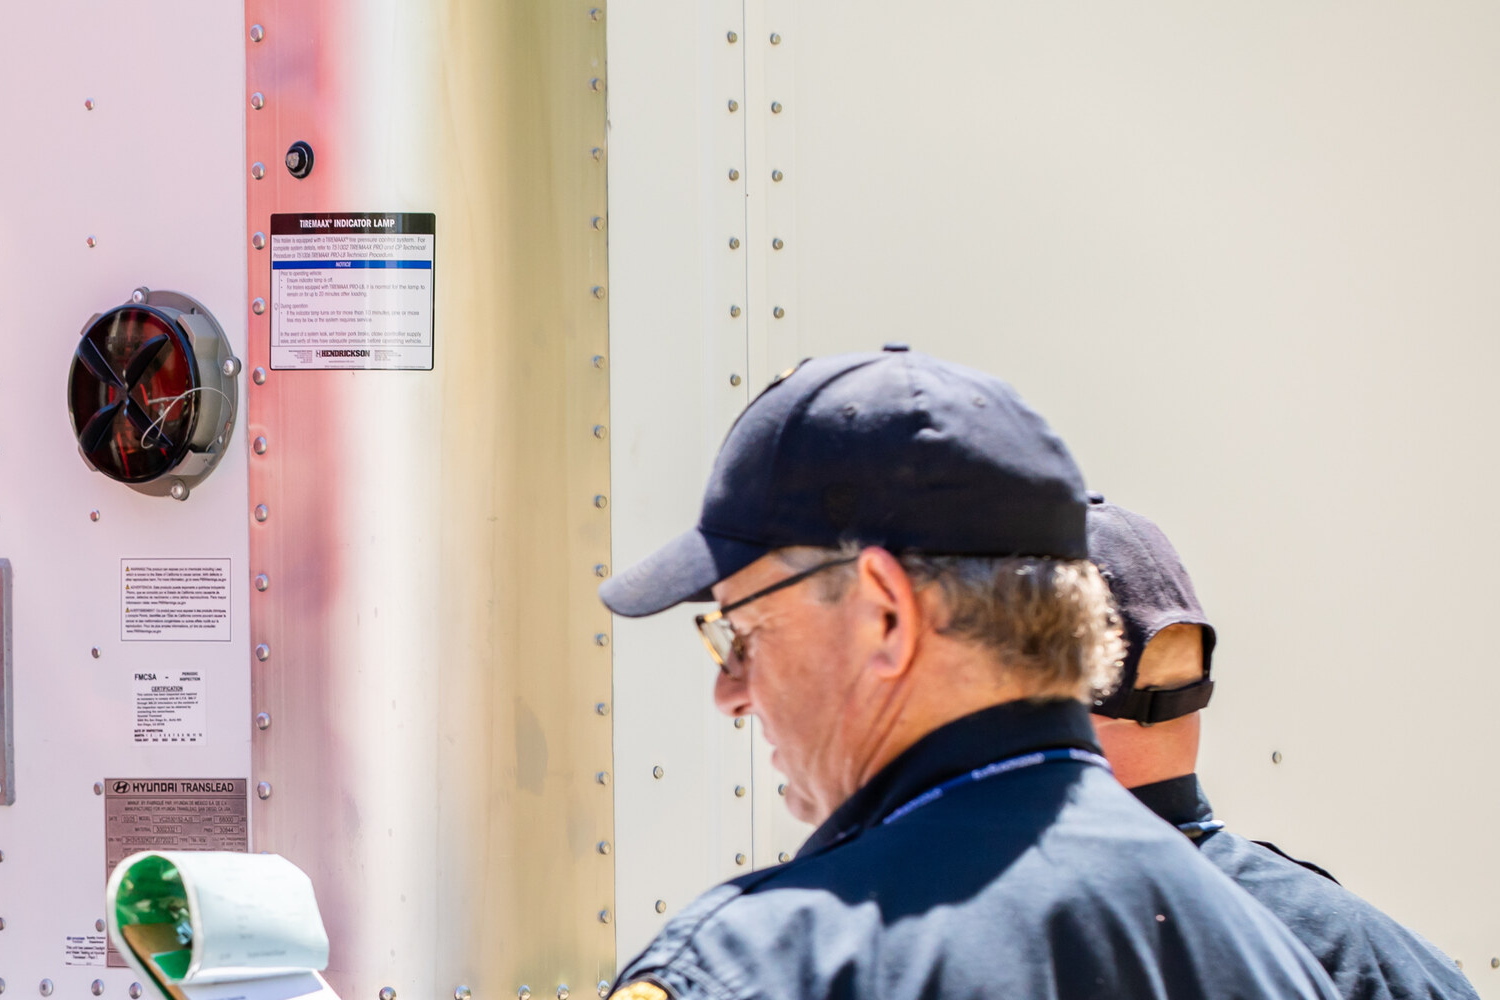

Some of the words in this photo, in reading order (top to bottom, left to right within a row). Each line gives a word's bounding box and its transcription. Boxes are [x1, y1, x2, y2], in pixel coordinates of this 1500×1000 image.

[333, 219, 372, 229] INDICATOR
[373, 219, 396, 229] LAMP
[321, 349, 371, 358] HENDRICKSON
[134, 673, 157, 681] FMCSA
[133, 783, 178, 793] HYUNDAI
[180, 782, 234, 793] TRANSLEAD
